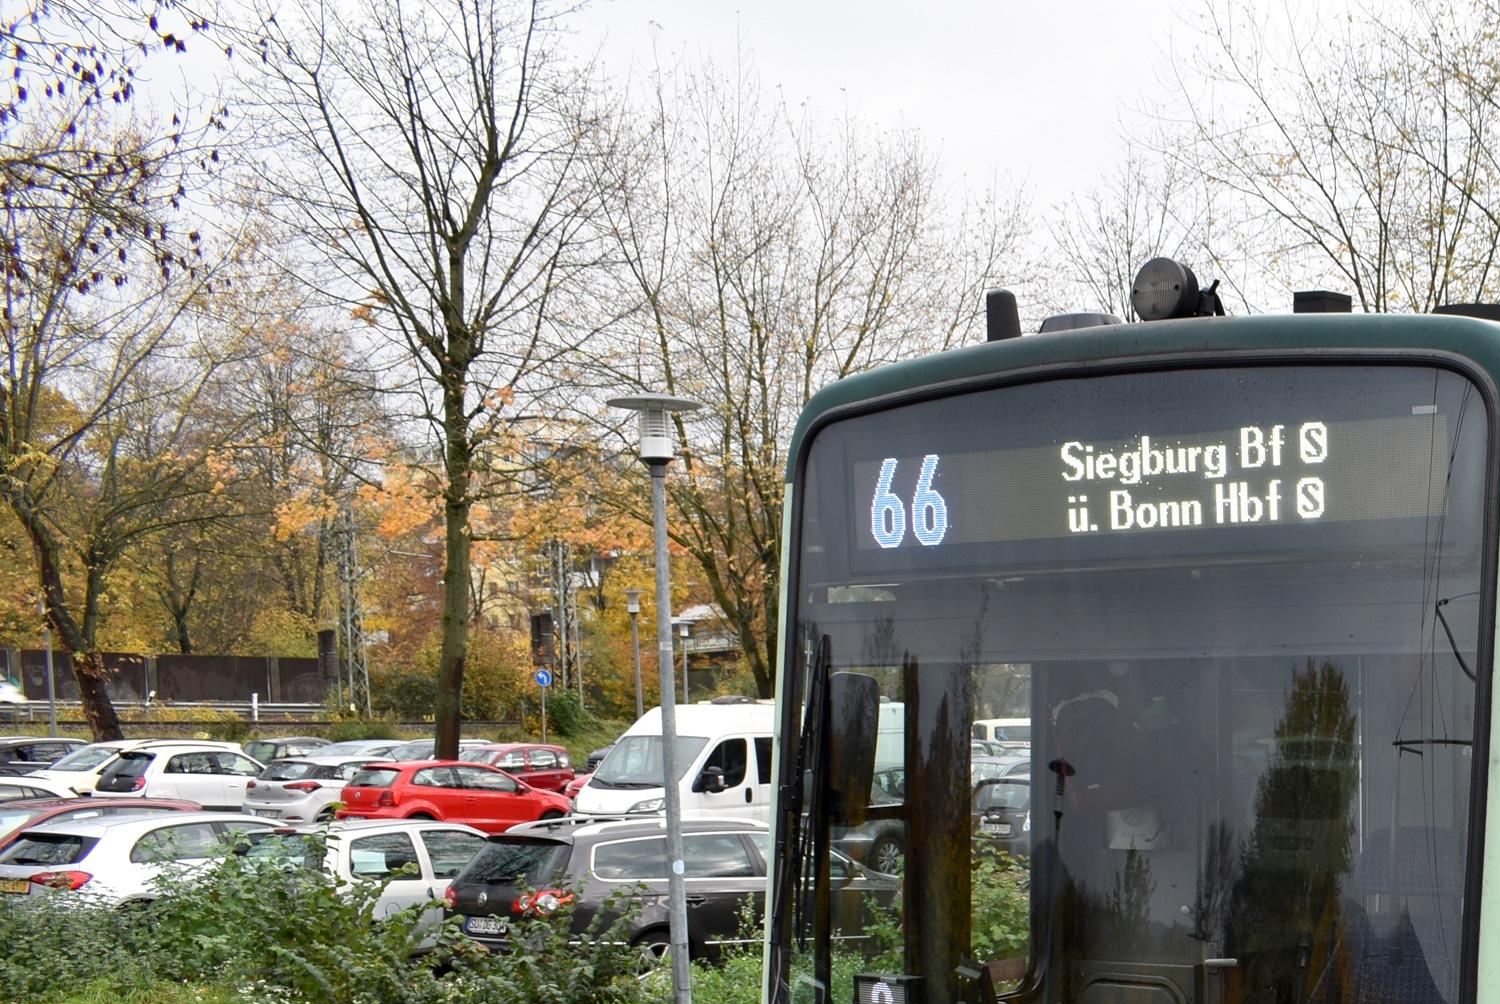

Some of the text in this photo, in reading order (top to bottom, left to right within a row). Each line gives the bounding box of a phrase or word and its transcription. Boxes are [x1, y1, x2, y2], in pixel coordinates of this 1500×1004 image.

[1061, 436, 1226, 484] Siegburg
[1240, 425, 1284, 468] Bf
[872, 454, 947, 548] 66
[1068, 495, 1098, 532] ü.
[1110, 490, 1201, 530] Bonn
[1215, 480, 1281, 524] Hbf
